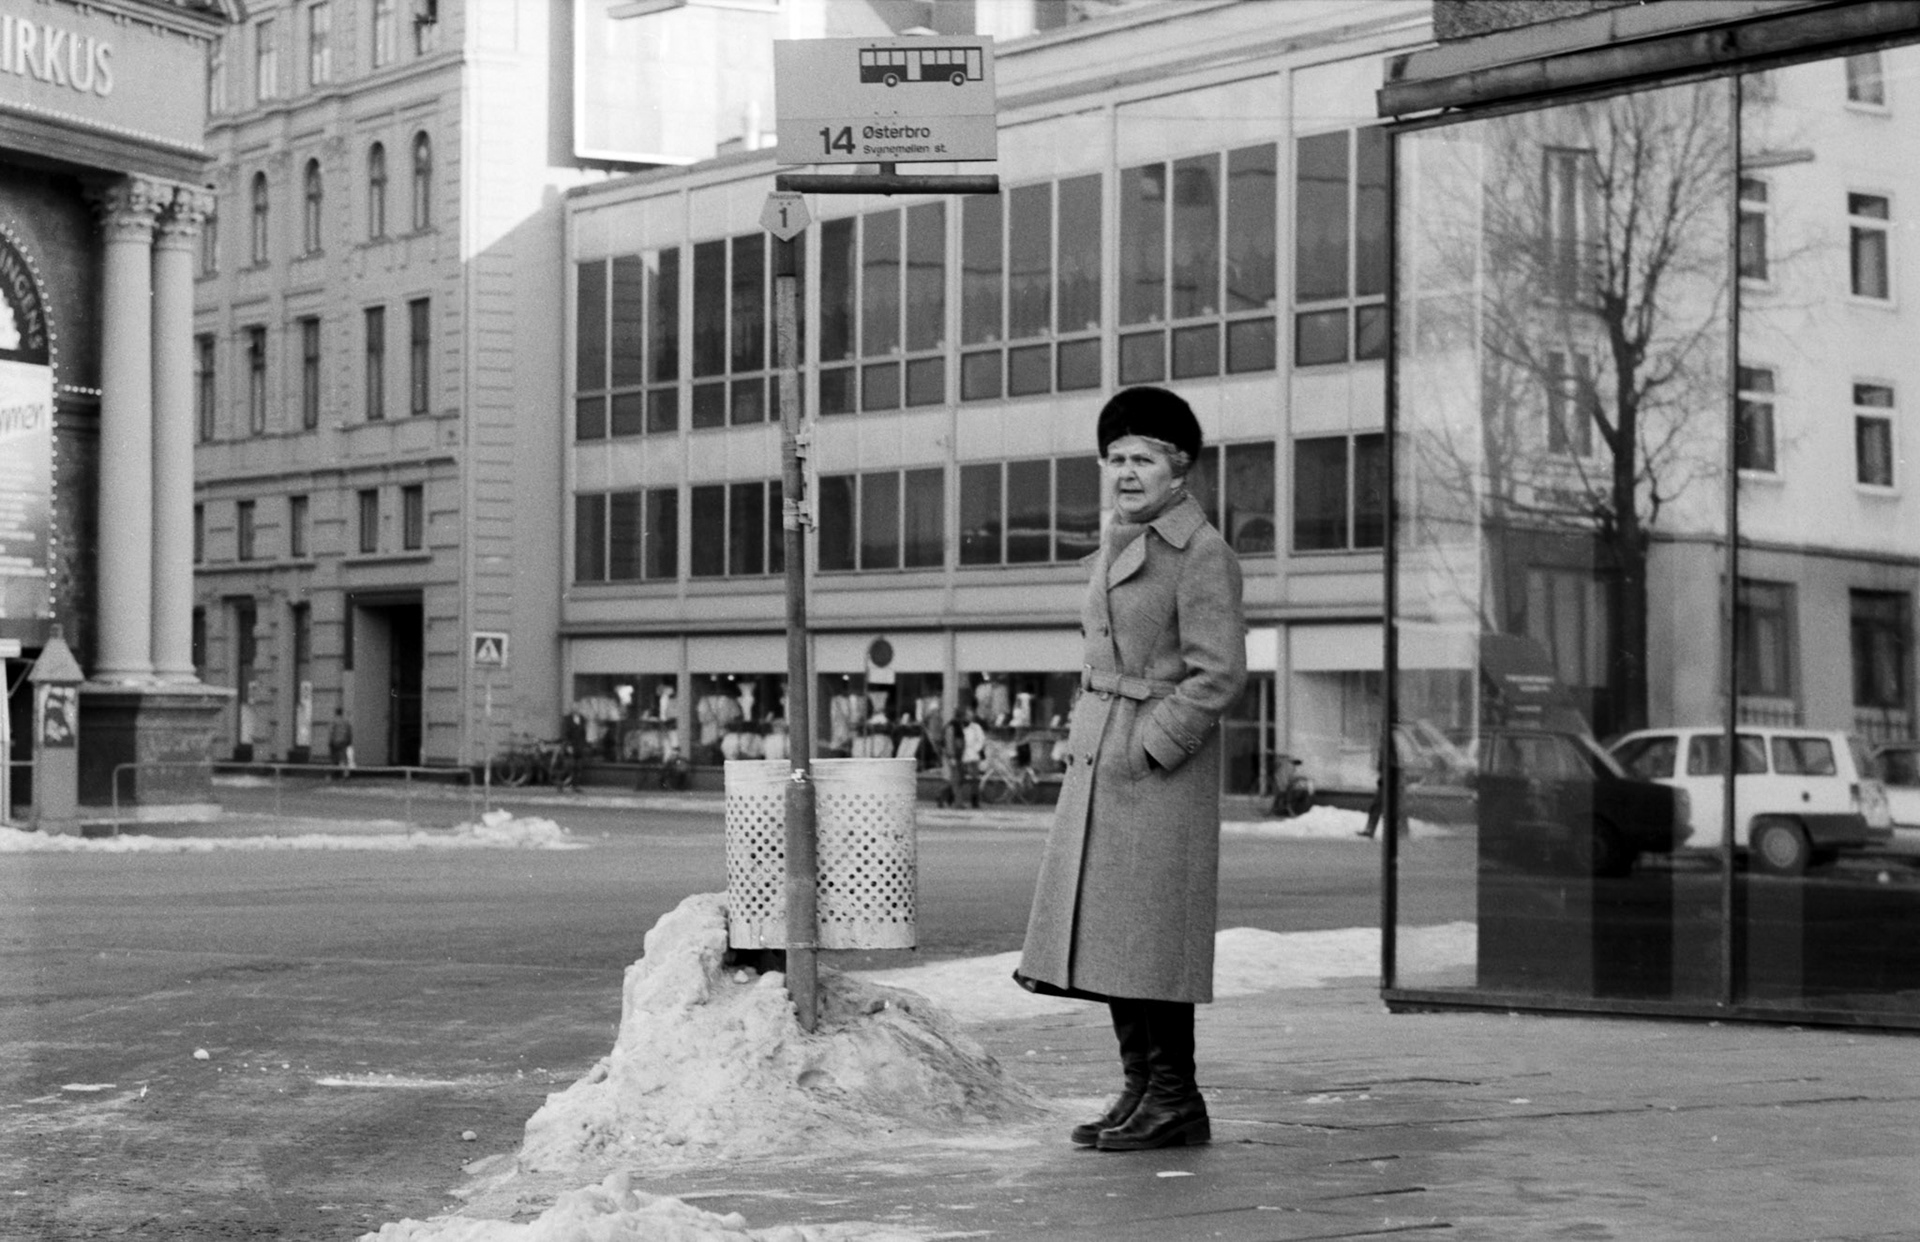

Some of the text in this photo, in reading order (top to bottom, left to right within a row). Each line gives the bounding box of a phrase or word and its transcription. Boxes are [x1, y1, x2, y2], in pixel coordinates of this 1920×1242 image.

[2, 14, 113, 96] IRKUS
[819, 126, 856, 155] 14
[862, 125, 931, 139] Østerbro
[779, 207, 787, 228] 1
